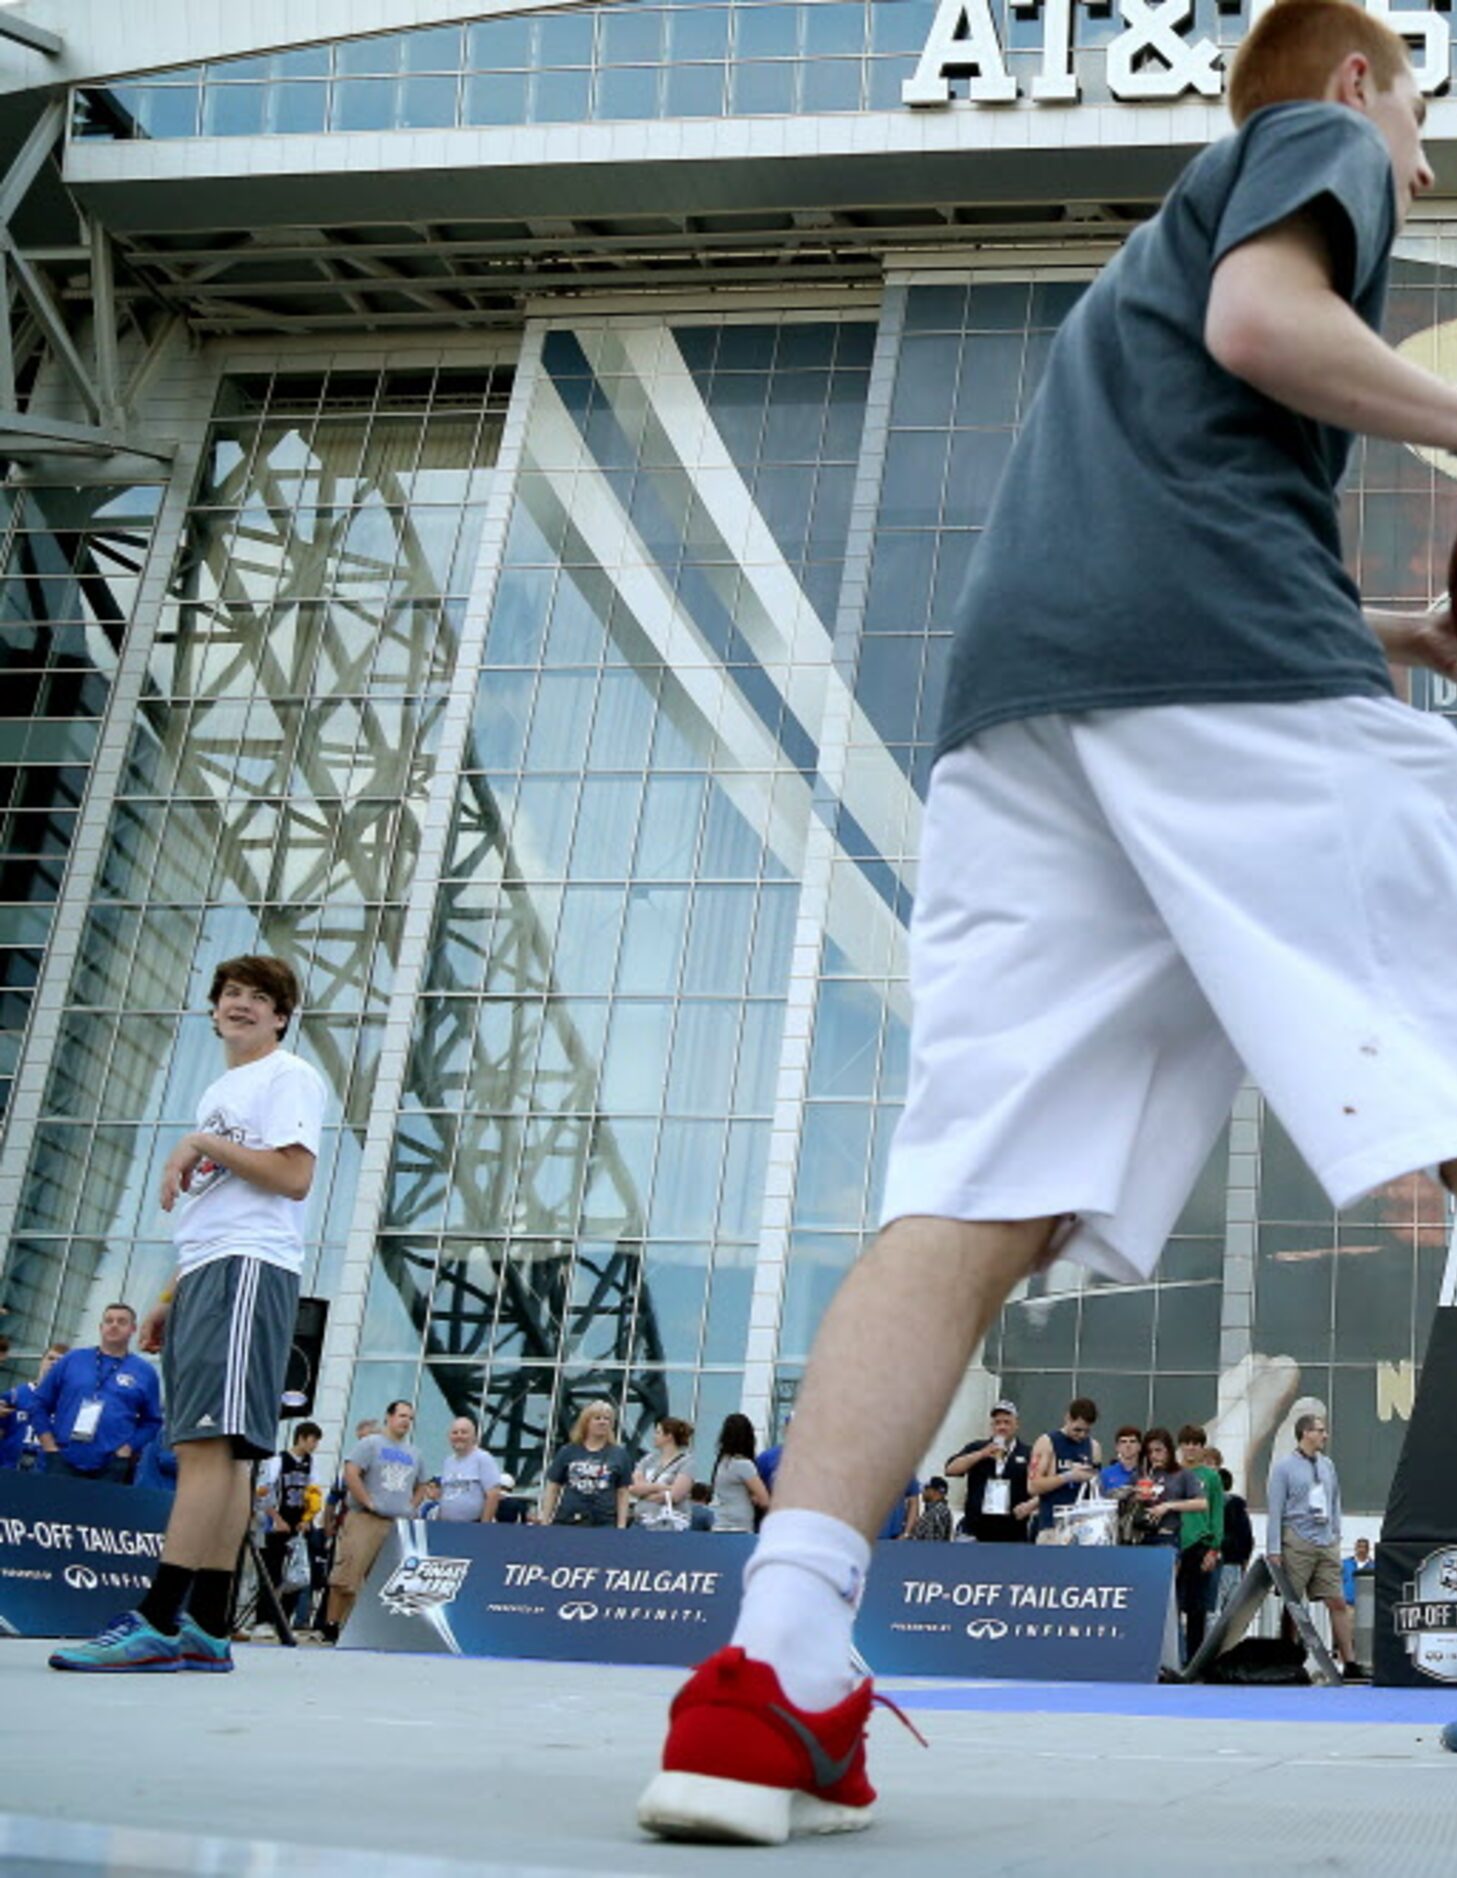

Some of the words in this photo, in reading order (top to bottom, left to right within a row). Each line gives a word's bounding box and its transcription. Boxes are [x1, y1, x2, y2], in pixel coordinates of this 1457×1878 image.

[901, 0, 1226, 104] AT&
[503, 1563, 600, 1589] TIP-OFF
[603, 1568, 719, 1594] TAILGATE
[903, 1581, 1003, 1607] TIP-OFF
[1008, 1584, 1130, 1609] TAILGATE
[1399, 1604, 1452, 1629] TIP-OFF
